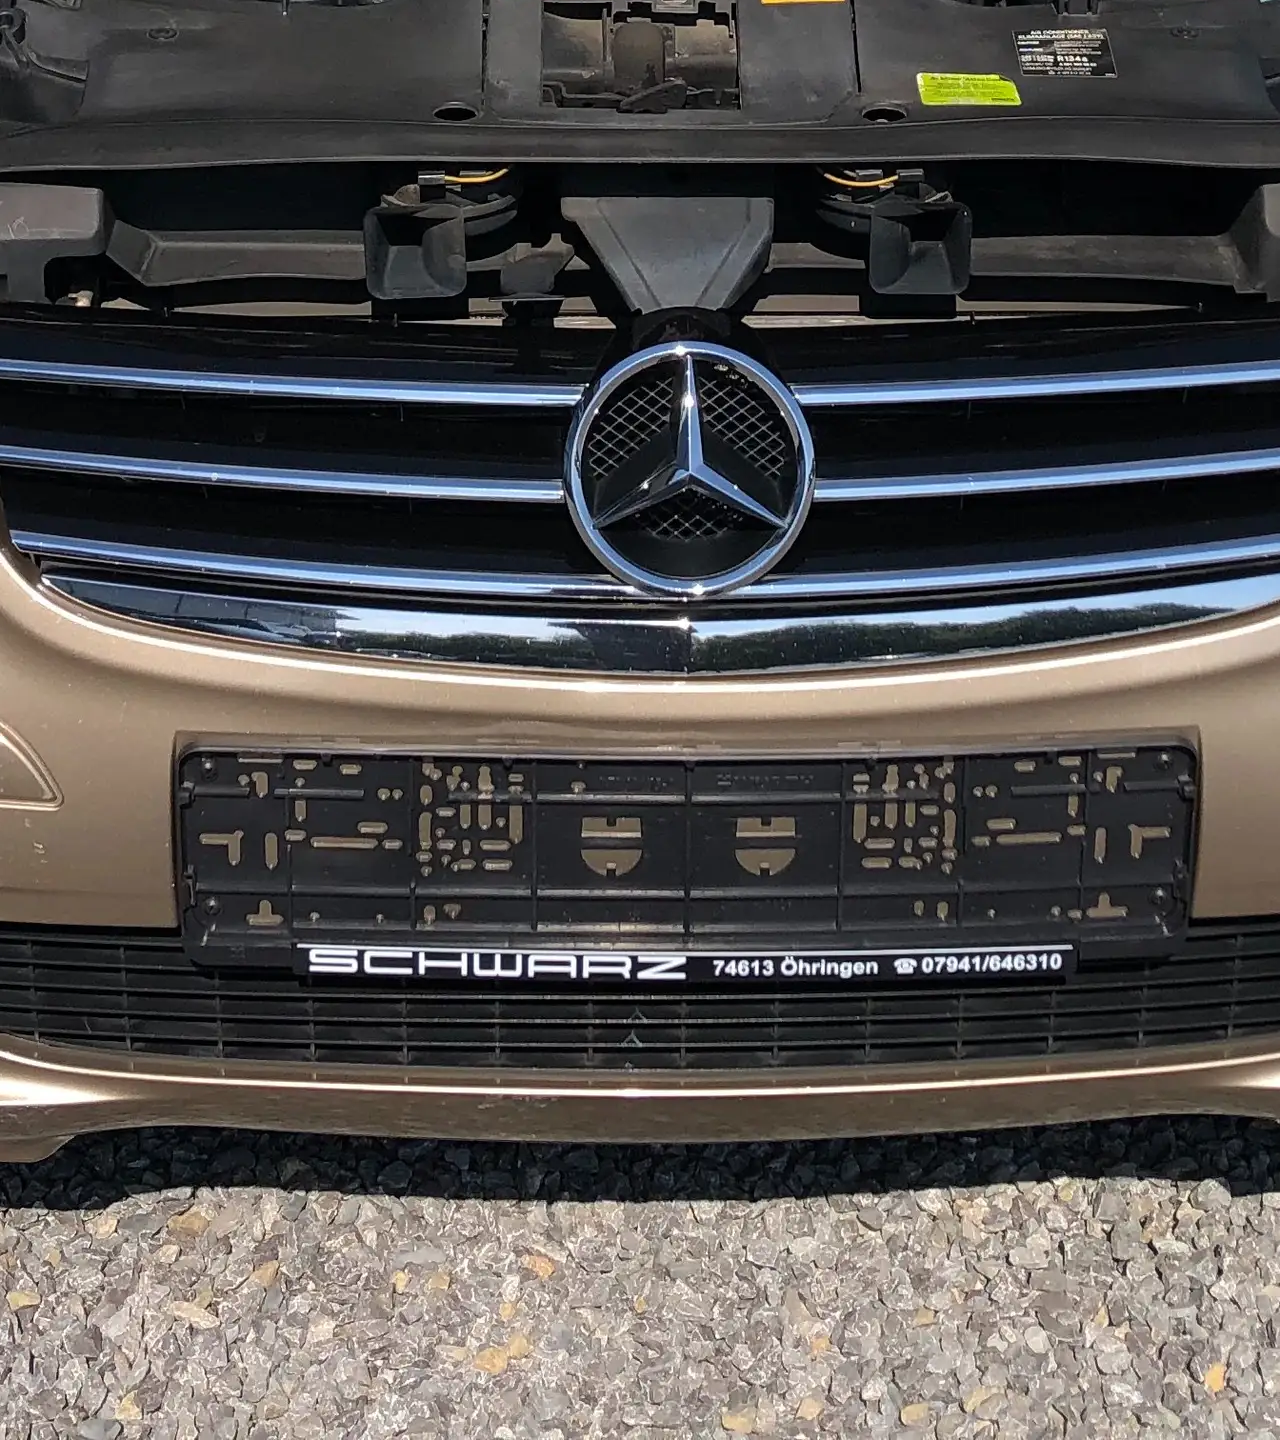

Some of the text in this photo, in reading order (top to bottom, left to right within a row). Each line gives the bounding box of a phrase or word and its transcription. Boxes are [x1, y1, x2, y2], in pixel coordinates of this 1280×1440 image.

[308, 948, 1063, 980] SCHWARZ 74613 Öhringen 07941/646310
